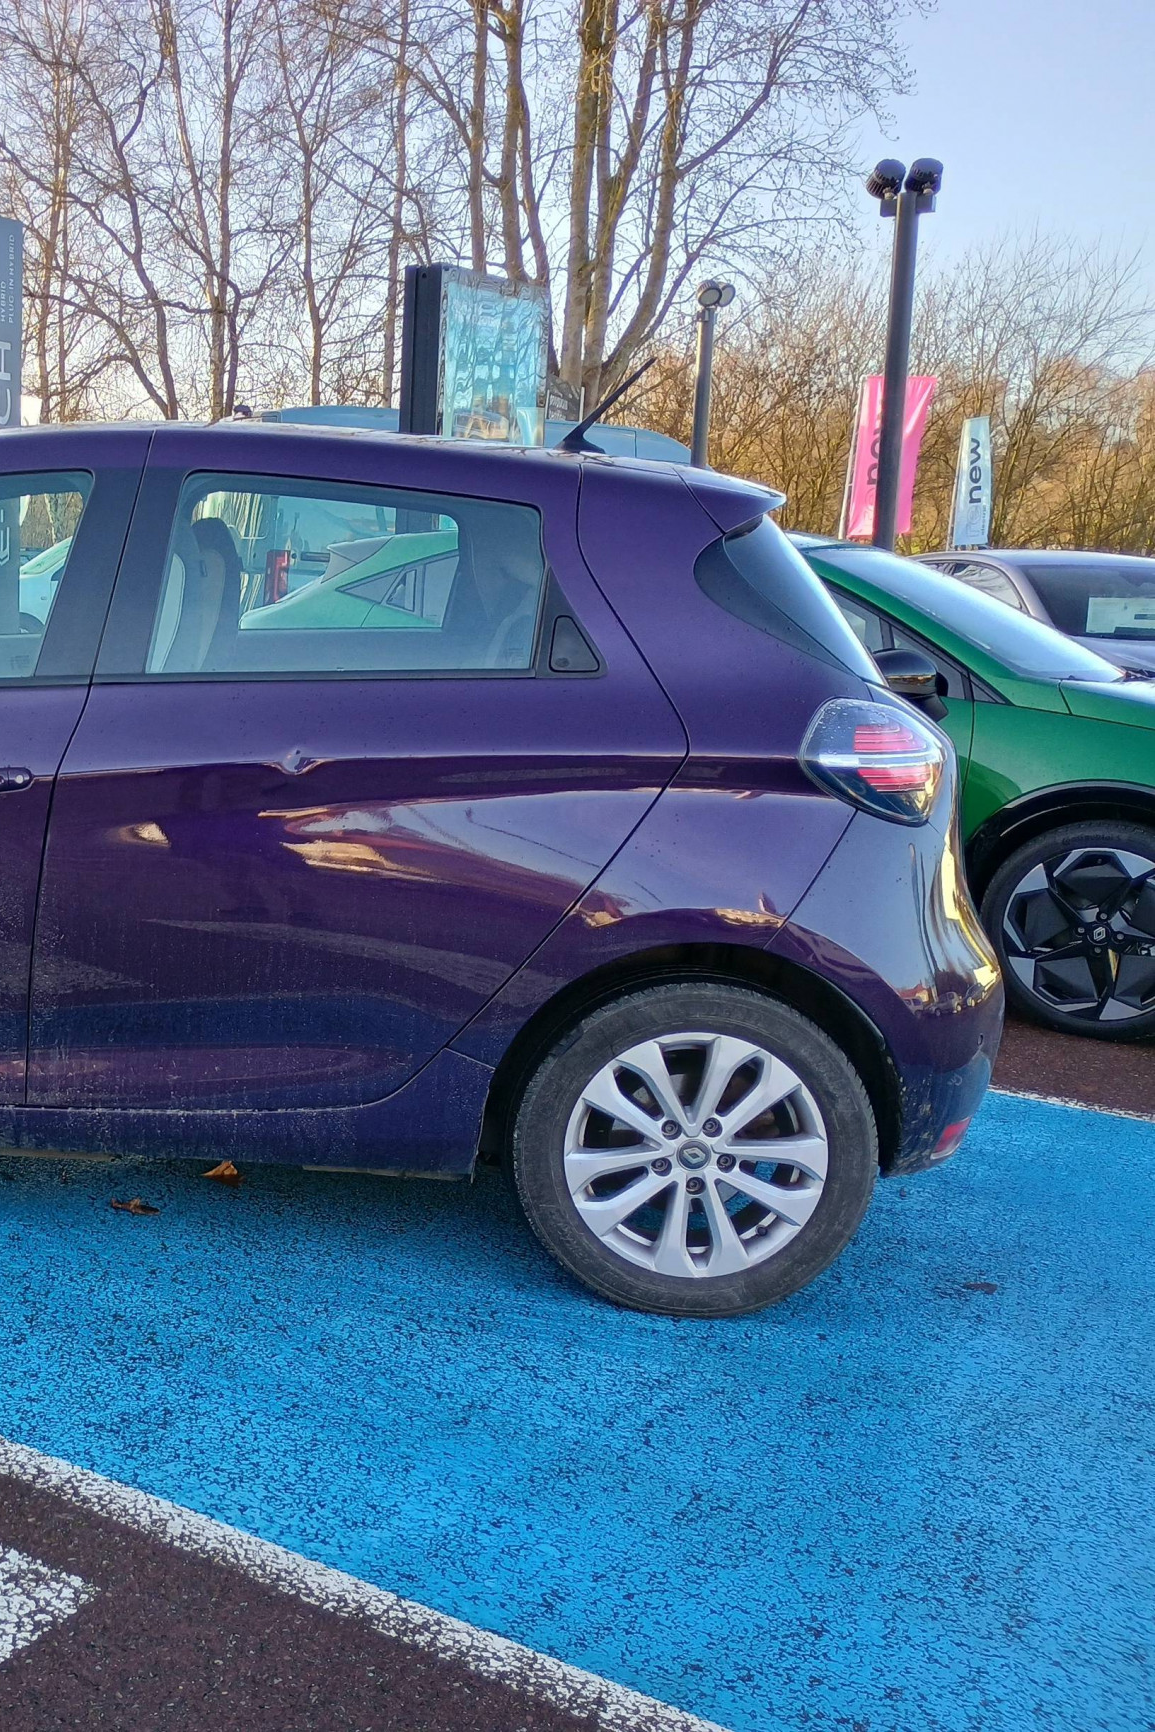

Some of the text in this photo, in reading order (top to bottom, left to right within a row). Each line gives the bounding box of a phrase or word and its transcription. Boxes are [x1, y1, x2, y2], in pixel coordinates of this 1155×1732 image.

[0, 280, 7, 322] HYBRID
[7, 234, 16, 324] PLUG-IN HYBRID
